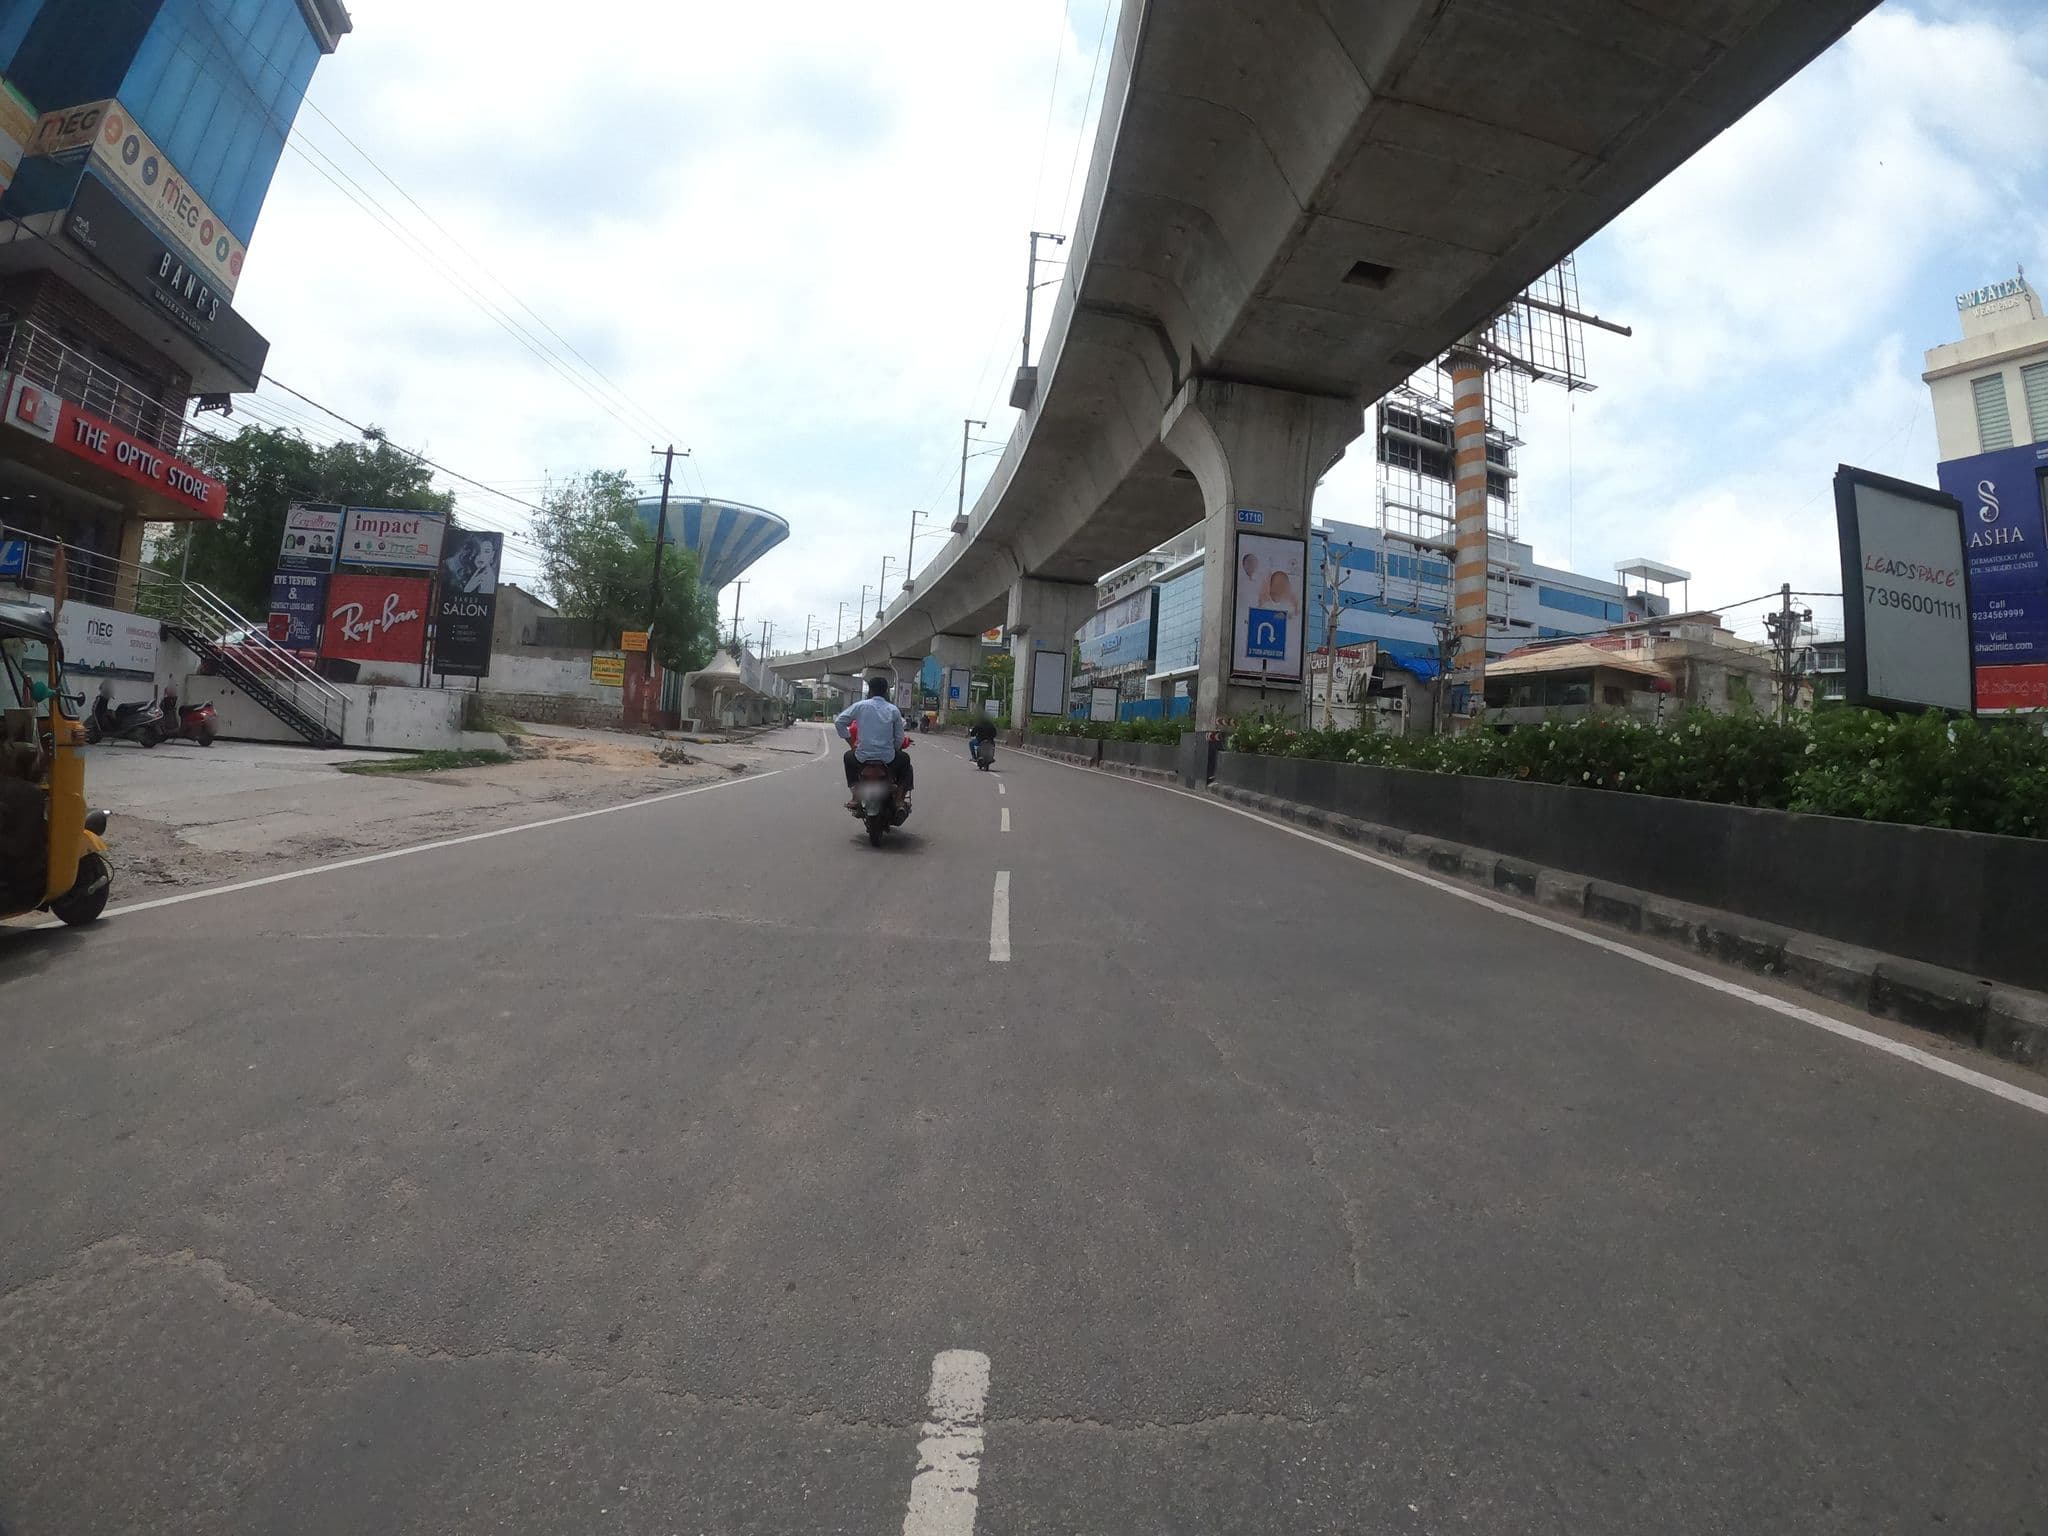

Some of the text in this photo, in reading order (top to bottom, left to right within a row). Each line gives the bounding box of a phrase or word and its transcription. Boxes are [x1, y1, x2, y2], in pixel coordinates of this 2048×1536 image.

[159, 252, 220, 322] BANGS
[1956, 279, 2024, 311] SWEATEX
[75, 417, 210, 502] THE OPTIC STORE
[355, 514, 420, 537] impact
[273, 575, 317, 586] EYE TESTING
[1865, 555, 1957, 587] LEADSPACE
[288, 587, 297, 600] &
[443, 602, 488, 617] SALON
[1865, 585, 1962, 620] 7396001111
[1989, 600, 2006, 609] Call
[332, 593, 419, 644] Ray-Ban
